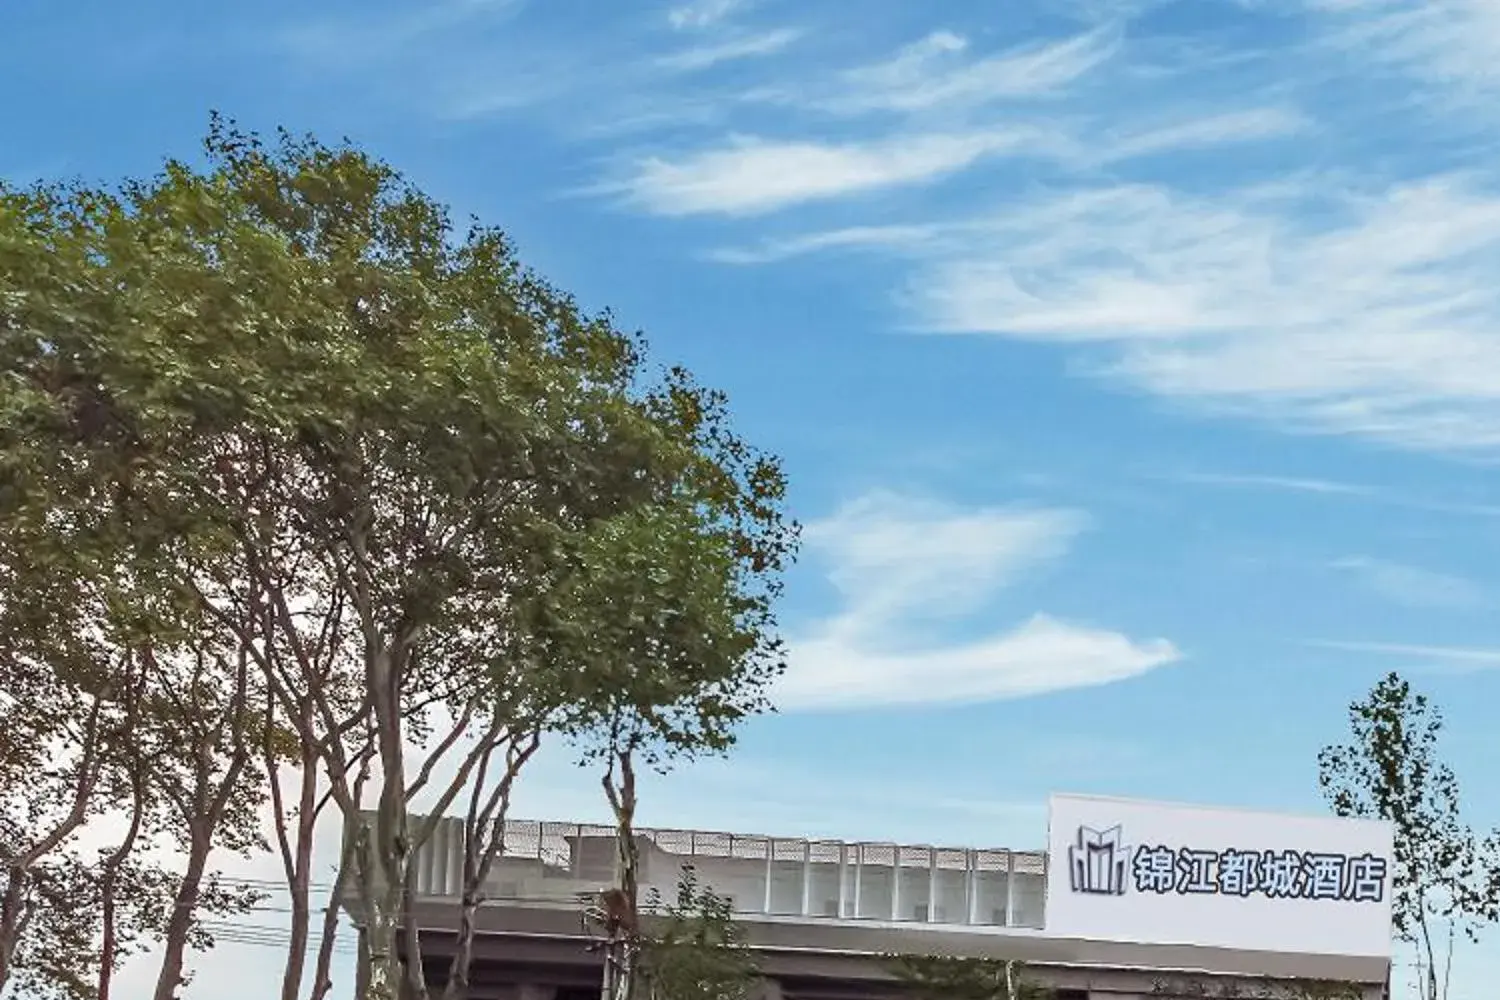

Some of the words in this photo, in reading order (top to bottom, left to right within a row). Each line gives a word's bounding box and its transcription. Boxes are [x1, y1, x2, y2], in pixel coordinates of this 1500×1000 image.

[1133, 845, 1387, 902] 锦江都城酒店
